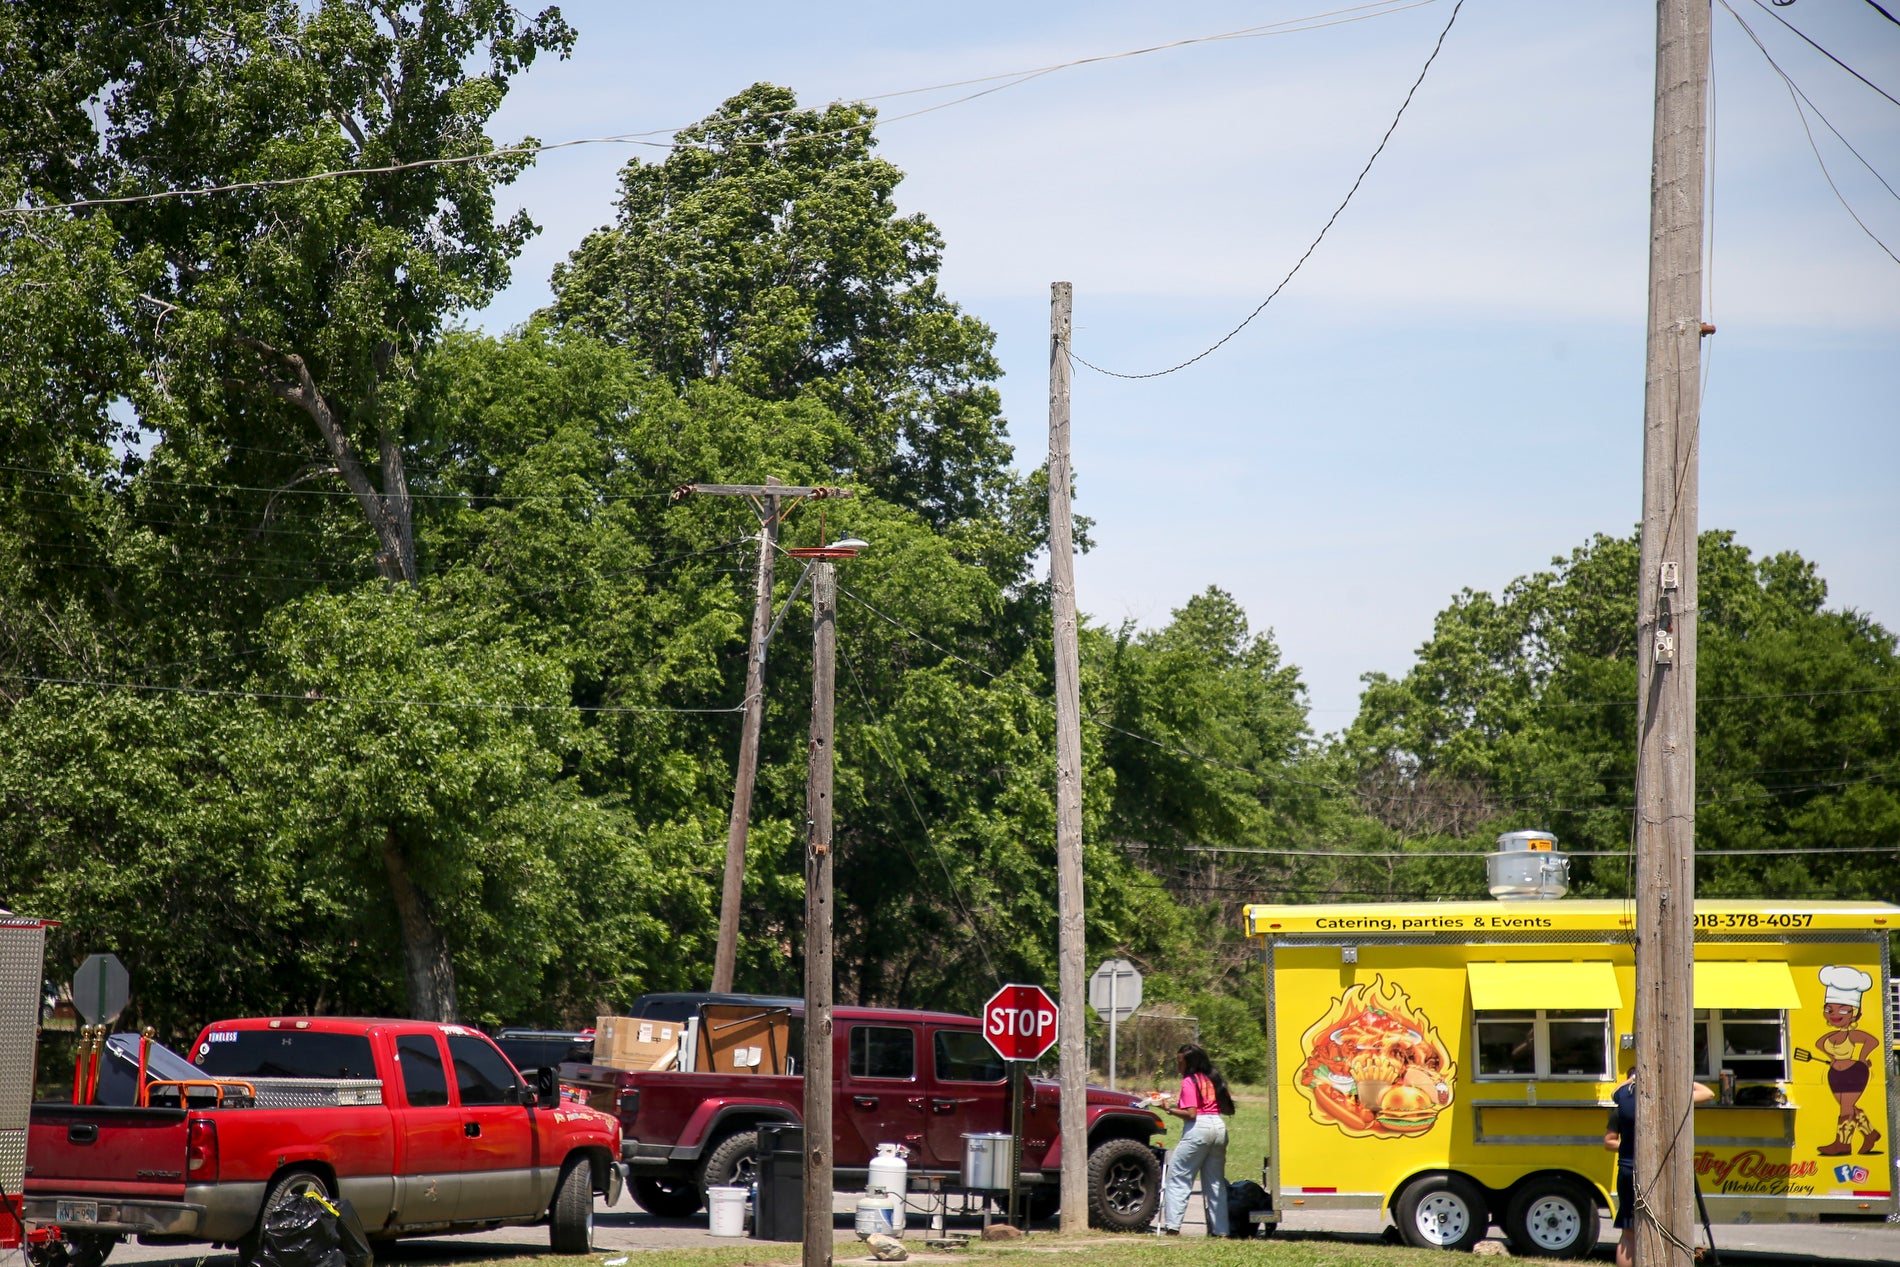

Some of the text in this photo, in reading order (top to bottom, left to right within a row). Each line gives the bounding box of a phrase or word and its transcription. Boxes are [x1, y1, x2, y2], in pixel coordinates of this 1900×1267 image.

[1315, 916, 1552, 930] Catering, parties & Events
[989, 1007, 1054, 1037] STOP
[1728, 1150, 1818, 1182] Queen
[1721, 1180, 1815, 1196] Mobile Eatery
